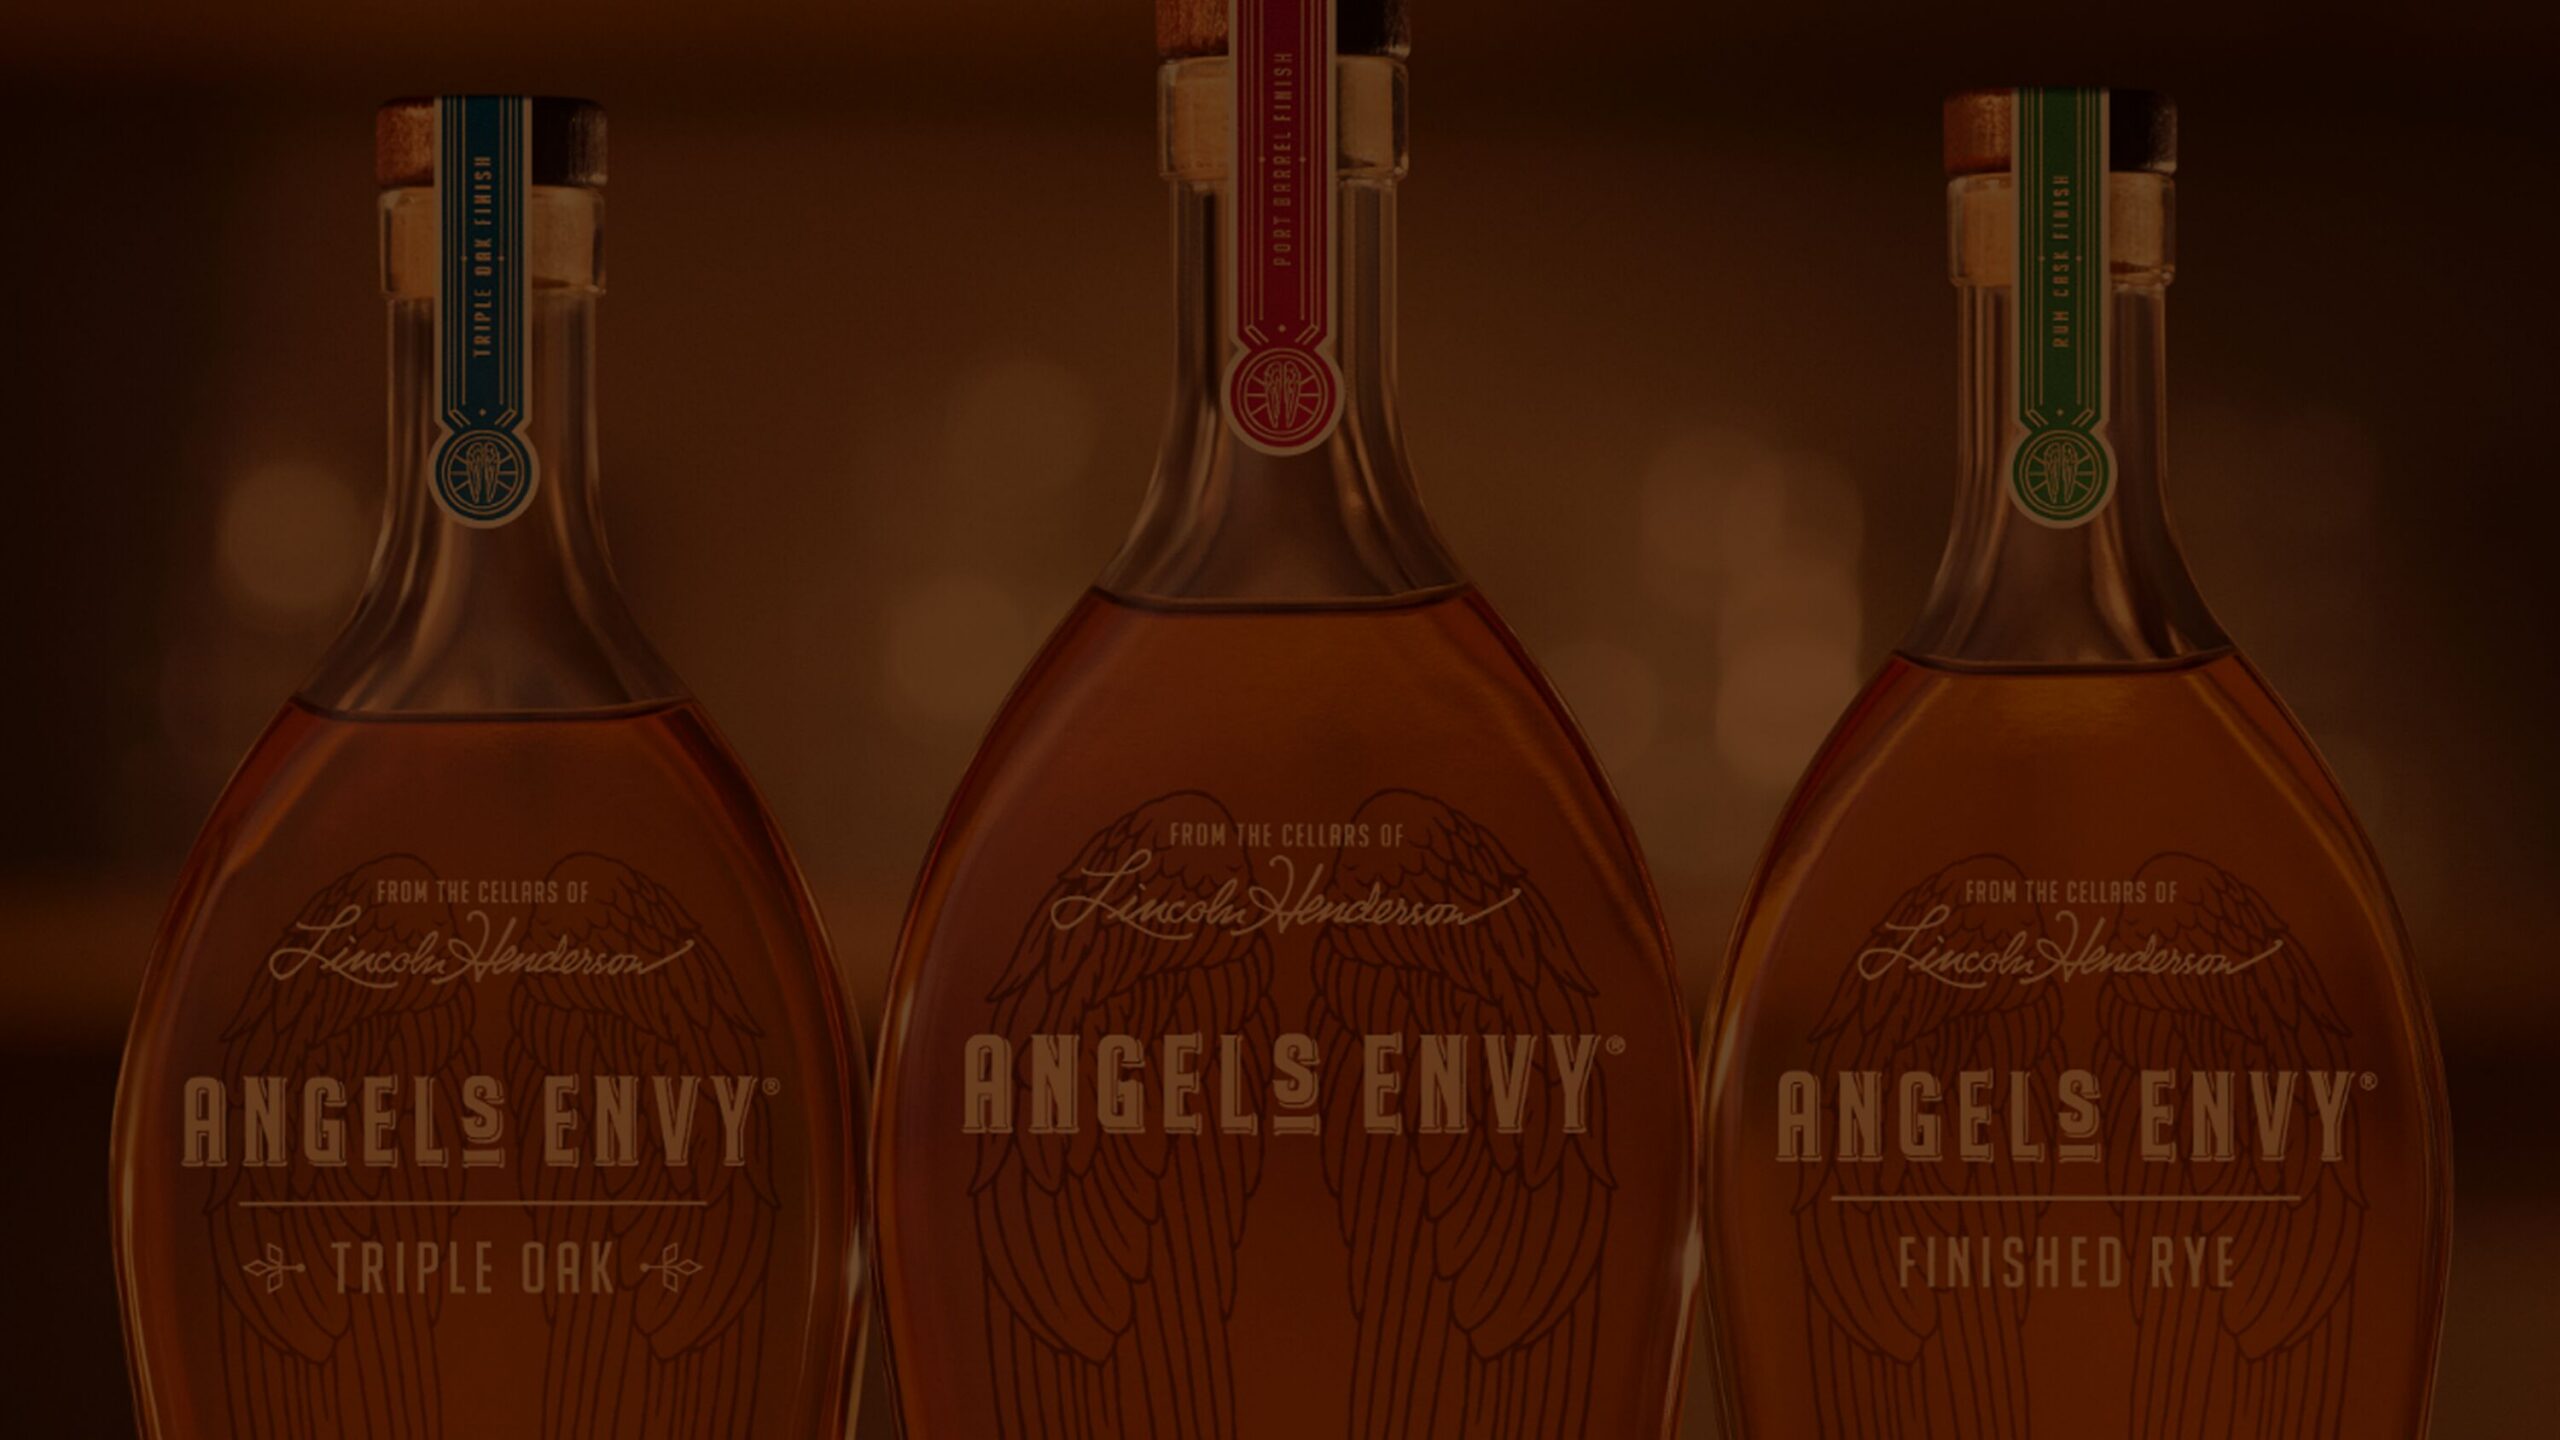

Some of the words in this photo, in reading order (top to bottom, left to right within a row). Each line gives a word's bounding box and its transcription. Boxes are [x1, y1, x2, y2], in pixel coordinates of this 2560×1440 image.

[1272, 52, 1292, 122] FINISH
[473, 155, 492, 225] FINISH
[1272, 131, 1291, 206] BARREL
[2053, 175, 2070, 239] FINISH
[474, 236, 492, 276] OAK
[1272, 216, 1291, 267] PORT
[2053, 250, 2070, 298] CASK
[474, 288, 492, 358] TRIPLE
[2053, 311, 2070, 349] RUM
[1169, 822, 1226, 848] FROM
[1236, 822, 1272, 848] THE
[1281, 822, 1371, 848] CELLARS
[1379, 822, 1404, 848] OF
[376, 880, 428, 903] FROM
[437, 880, 470, 903] THE
[477, 880, 559, 904] CELLARS
[566, 880, 589, 903] OF
[1050, 849, 1250, 941] Lincoln
[1231, 854, 1522, 937] Henderson
[1965, 880, 2016, 903] FROM
[2025, 880, 2058, 903] THE
[2066, 880, 2147, 904] CELLARS
[2154, 880, 2178, 903] OF
[268, 904, 447, 988] Lincoln
[431, 909, 694, 985] Henderson
[1857, 904, 2036, 988] Lincoln
[2020, 909, 2283, 985] Henderson
[961, 1031, 1320, 1137] ANGELS
[1775, 1068, 2102, 1164] ANGELS
[180, 1073, 506, 1169] ANGELS
[332, 1241, 494, 1295] TRIPLE
[522, 1241, 615, 1295] OAK
[1899, 1236, 2123, 1289] FINISHED
[2150, 1236, 2235, 1289] RYE
